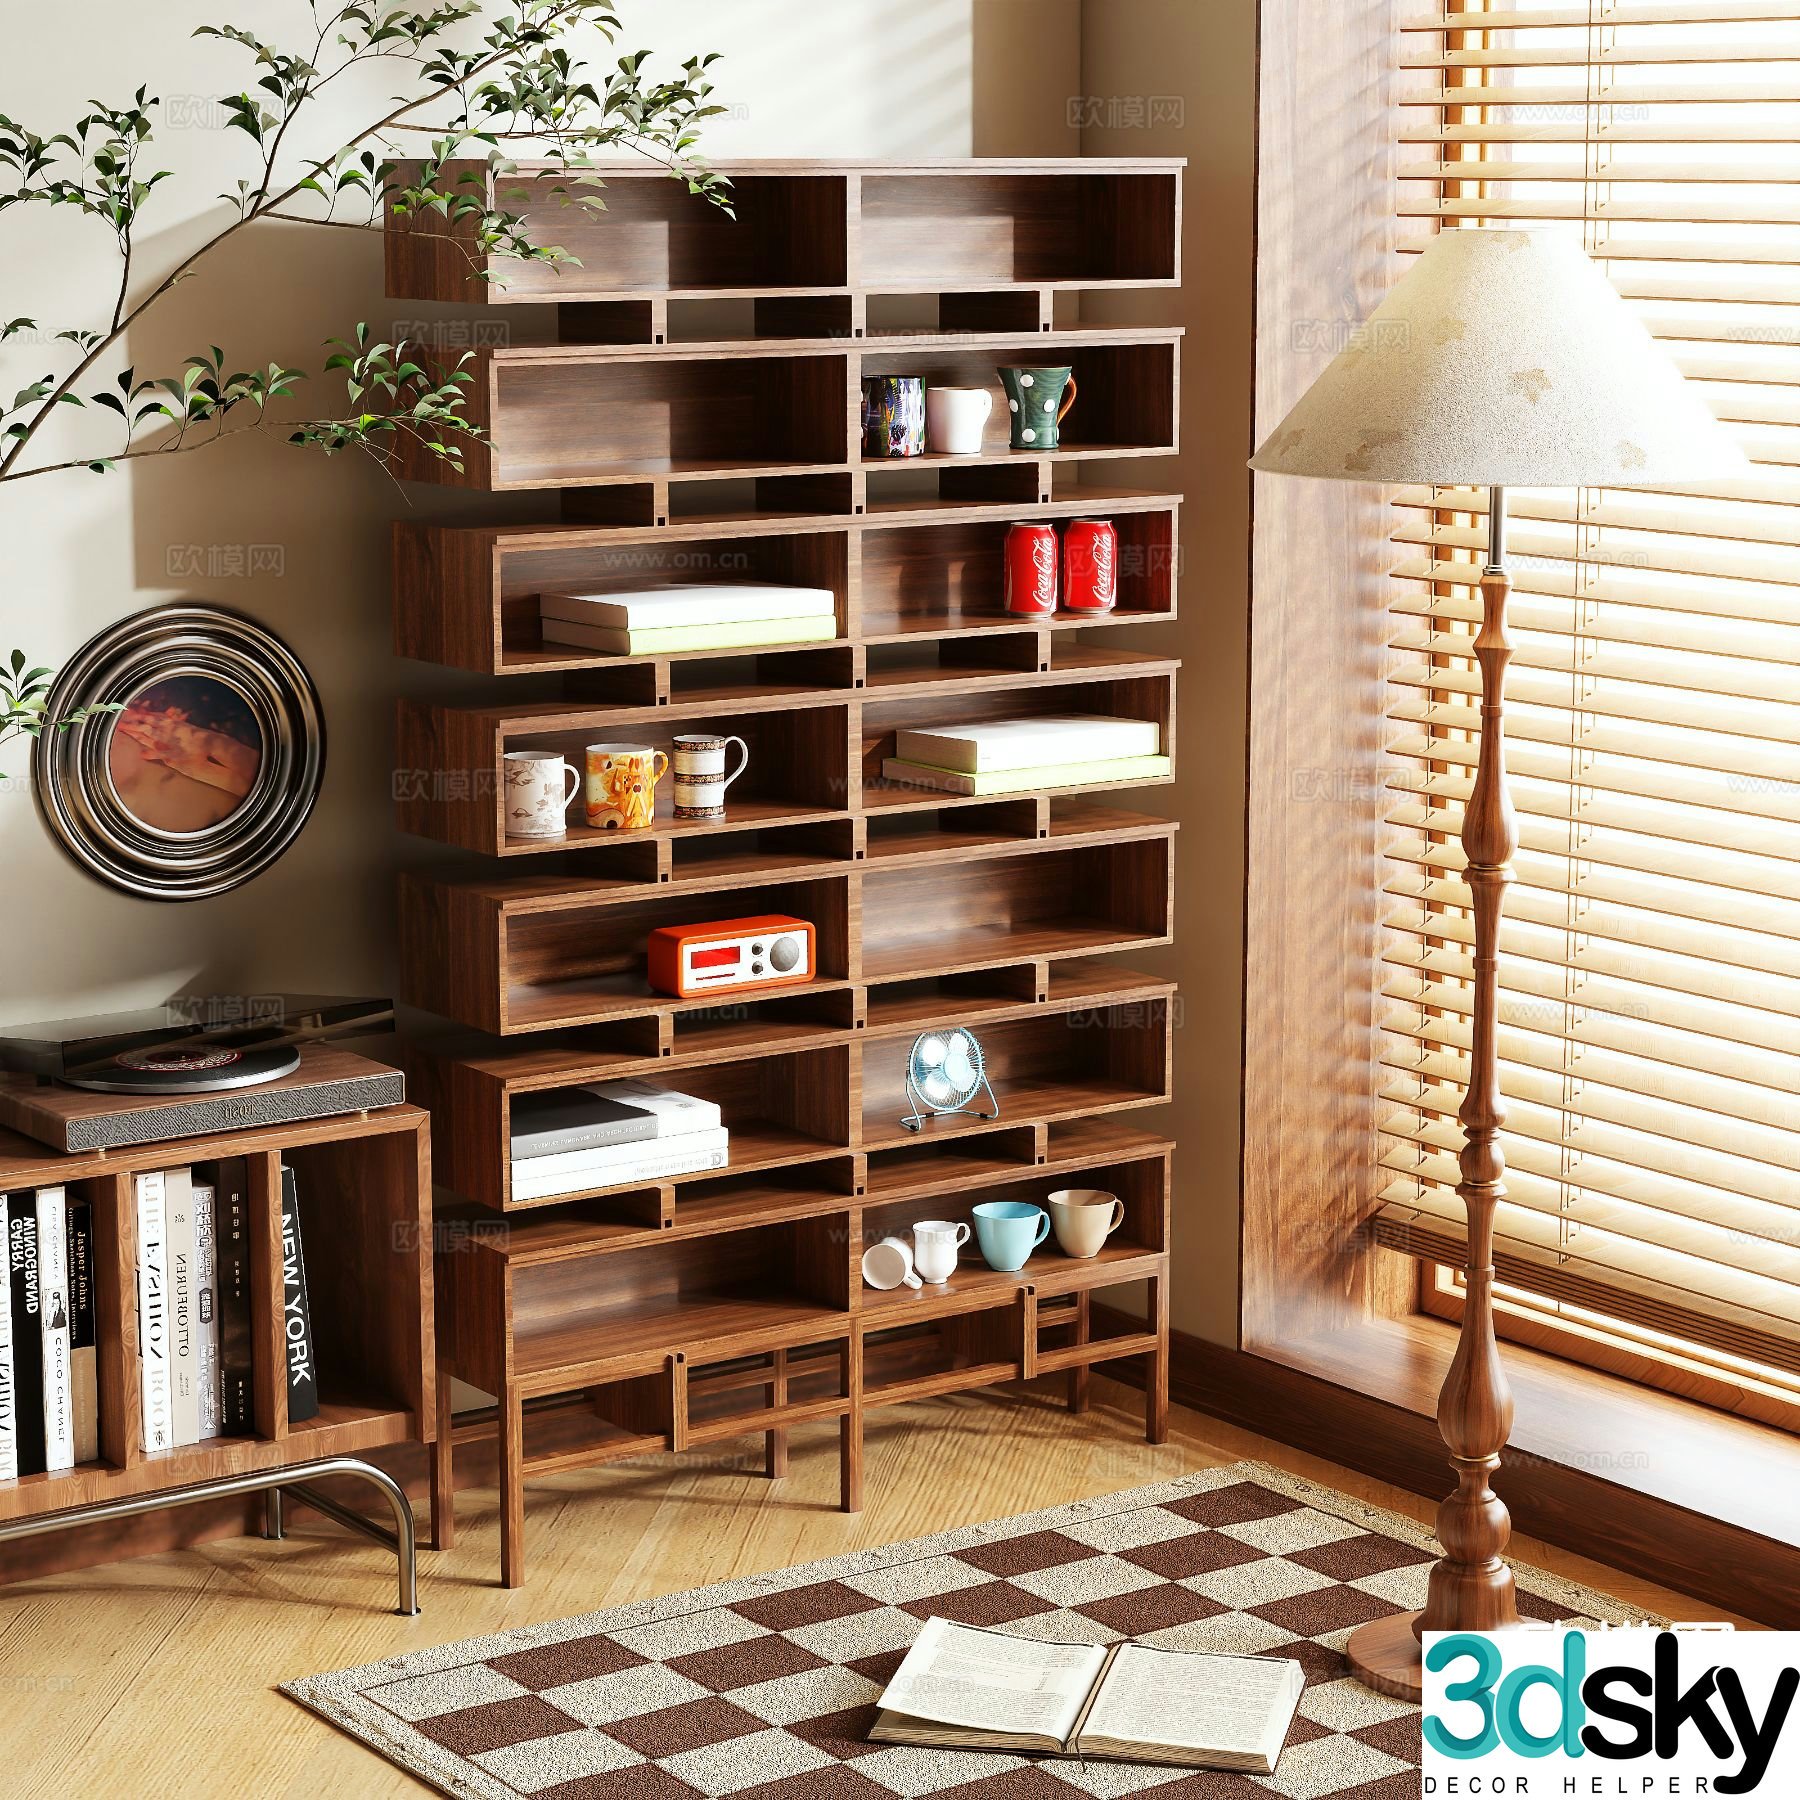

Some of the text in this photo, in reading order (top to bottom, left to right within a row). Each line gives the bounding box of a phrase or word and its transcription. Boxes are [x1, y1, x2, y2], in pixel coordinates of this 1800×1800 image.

[77, 1231, 88, 1310] Jasper Johns
[282, 1213, 311, 1387] NEW YORK
